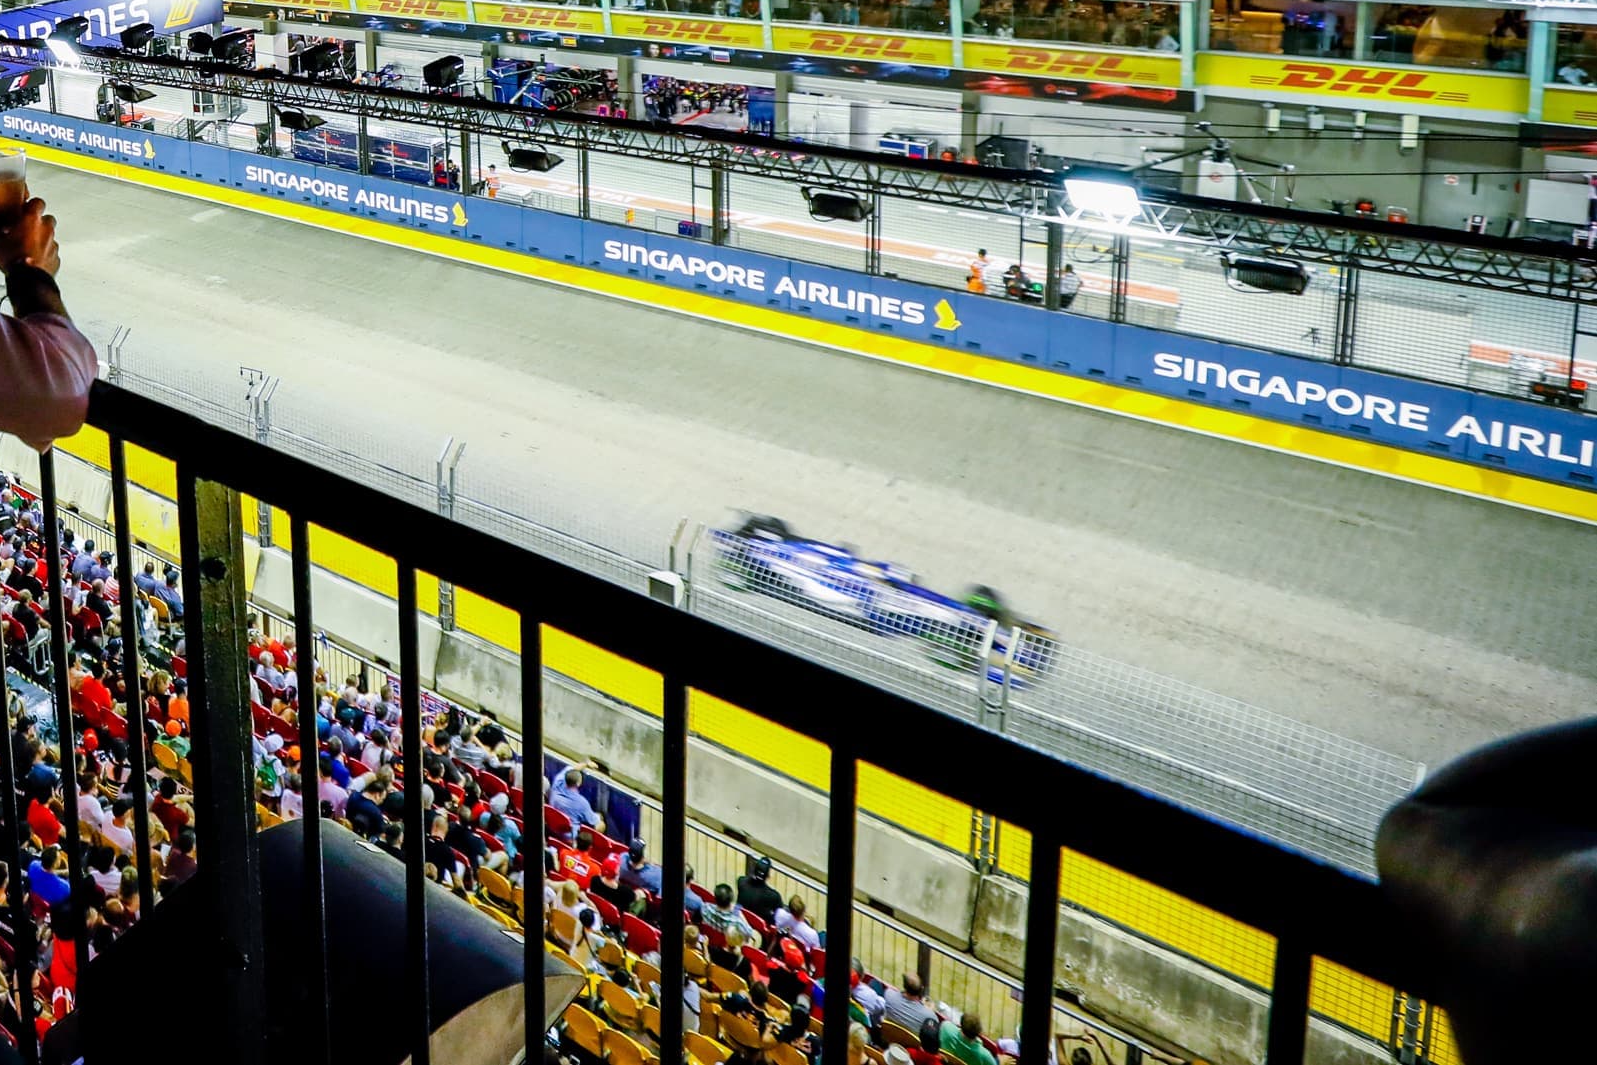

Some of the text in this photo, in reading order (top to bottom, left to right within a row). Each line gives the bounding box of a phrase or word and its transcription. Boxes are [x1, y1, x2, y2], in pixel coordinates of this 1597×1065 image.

[500, 7, 578, 30] DHL
[642, 19, 732, 42] DHL
[808, 32, 915, 59] DHL
[1006, 48, 1132, 78] DHL
[1279, 64, 1436, 99] DHL
[4, 115, 142, 157] SINGAPORE AIRLINES
[245, 165, 449, 224] SINGAPORE AIRLINES
[604, 240, 925, 325] SINGAPORE AIRLINES
[1153, 352, 1595, 467] SINGAPORE AIRLI
